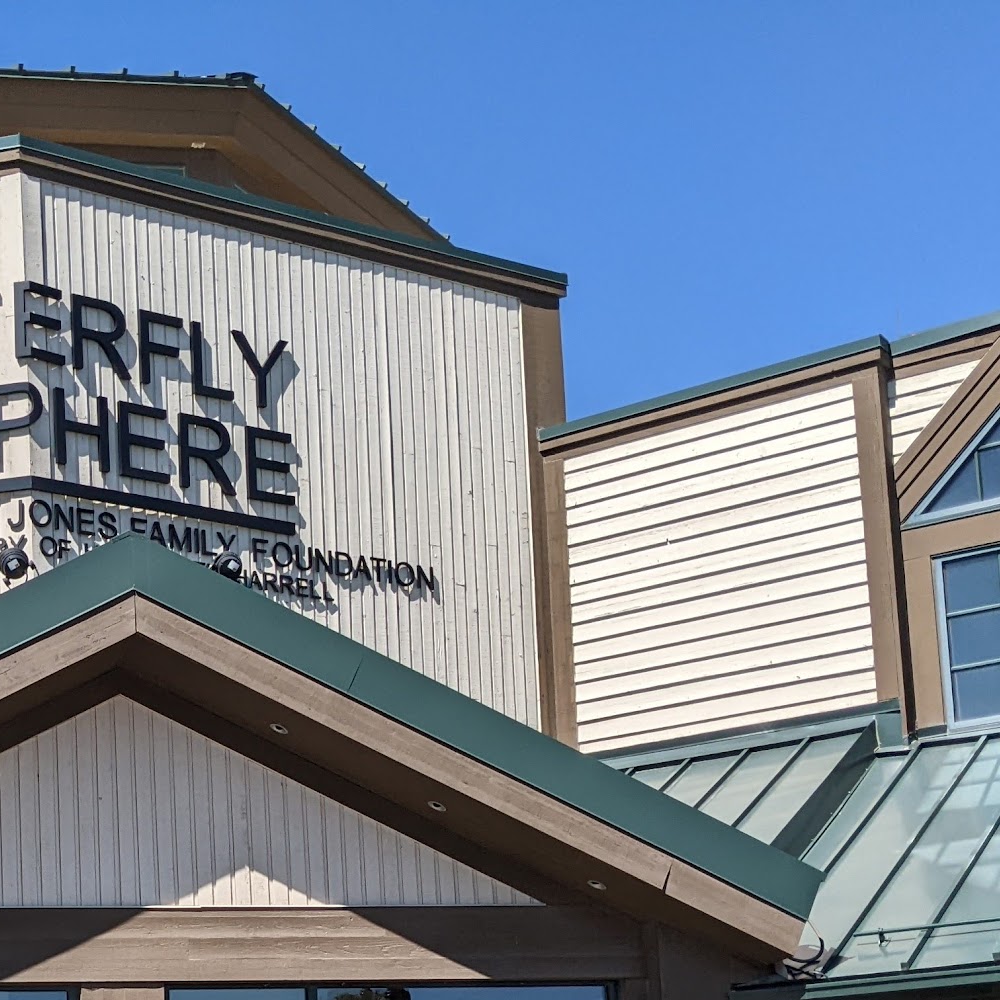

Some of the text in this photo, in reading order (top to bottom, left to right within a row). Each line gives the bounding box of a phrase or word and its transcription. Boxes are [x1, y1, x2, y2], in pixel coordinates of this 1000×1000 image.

[7, 500, 118, 540] JONES
[252, 538, 435, 592] FOUNDATION
[39, 536, 71, 558] OF
